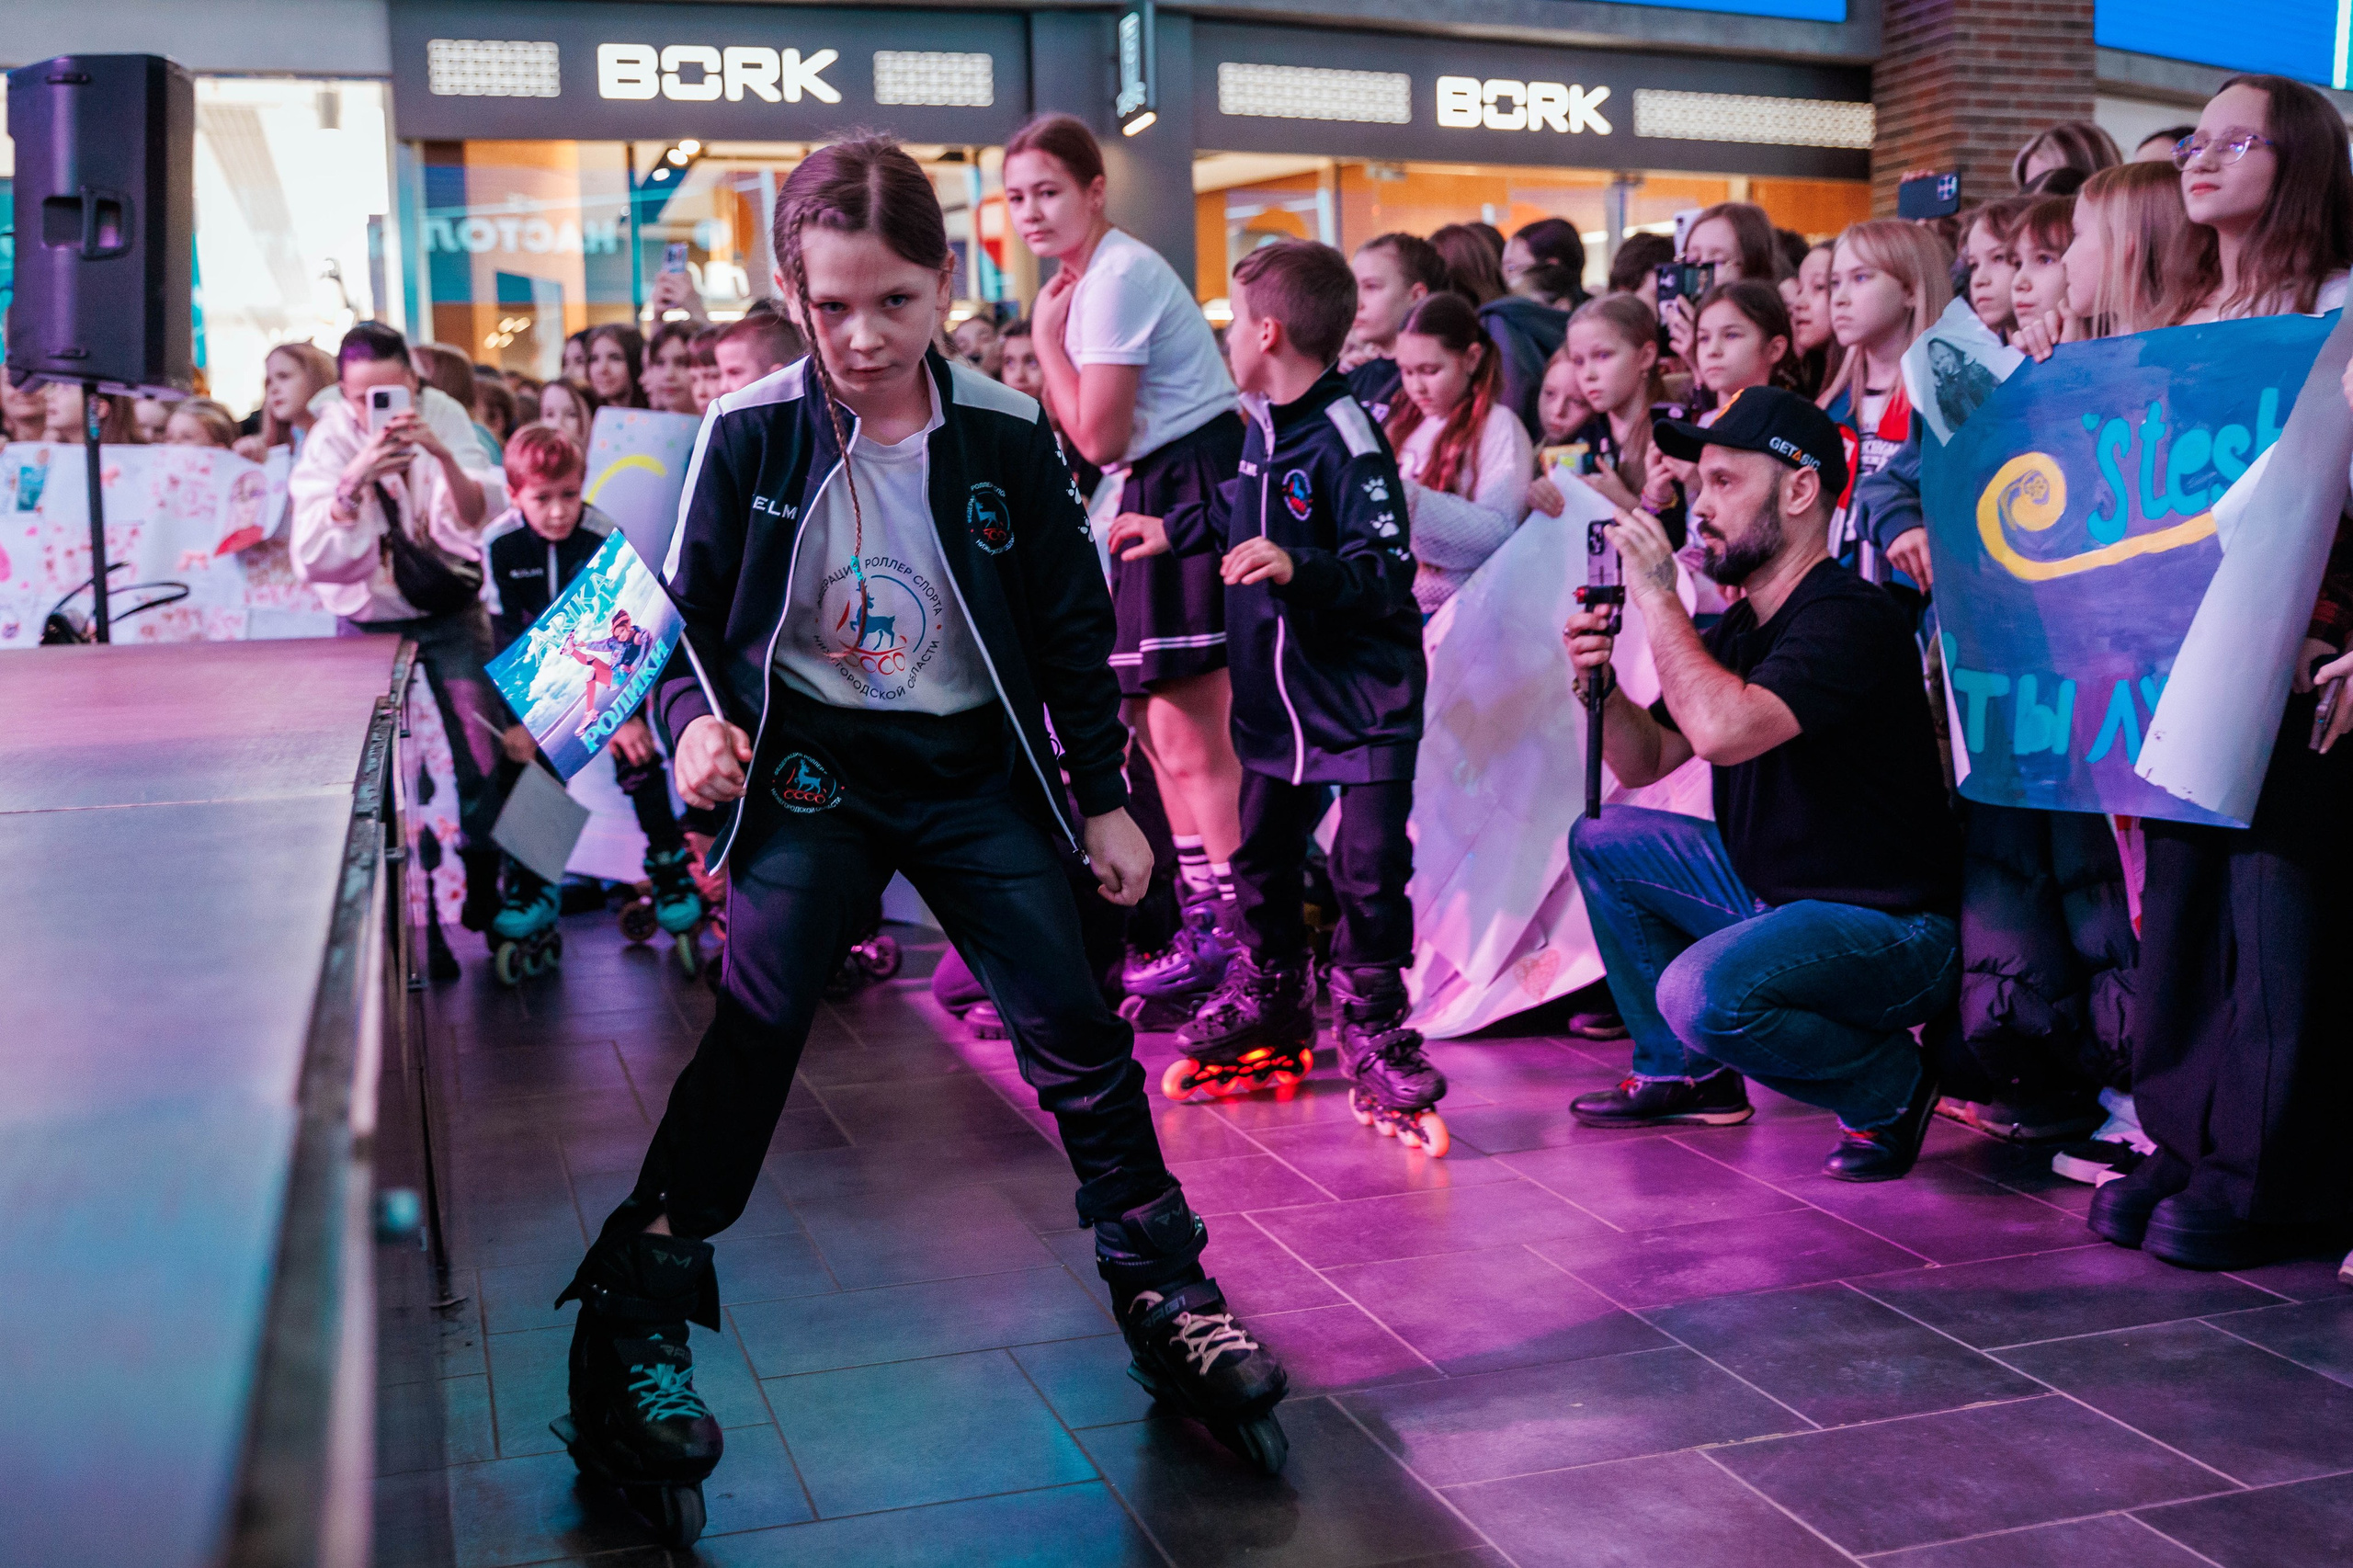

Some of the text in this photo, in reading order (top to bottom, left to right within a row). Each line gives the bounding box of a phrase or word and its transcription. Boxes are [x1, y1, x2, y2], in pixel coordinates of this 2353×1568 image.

[597, 43, 842, 103] BORK
[1437, 76, 1613, 135] BORK
[865, 556, 913, 575] РОЛЛЕР
[913, 574, 943, 617] СПОРТА
[527, 572, 615, 668] ARIKA
[579, 636, 670, 755] РОЛИКИ
[813, 634, 940, 700] НИГОРОДСКОЙ ОБЛАСТИ
[1953, 667, 2077, 756] ТЫ
